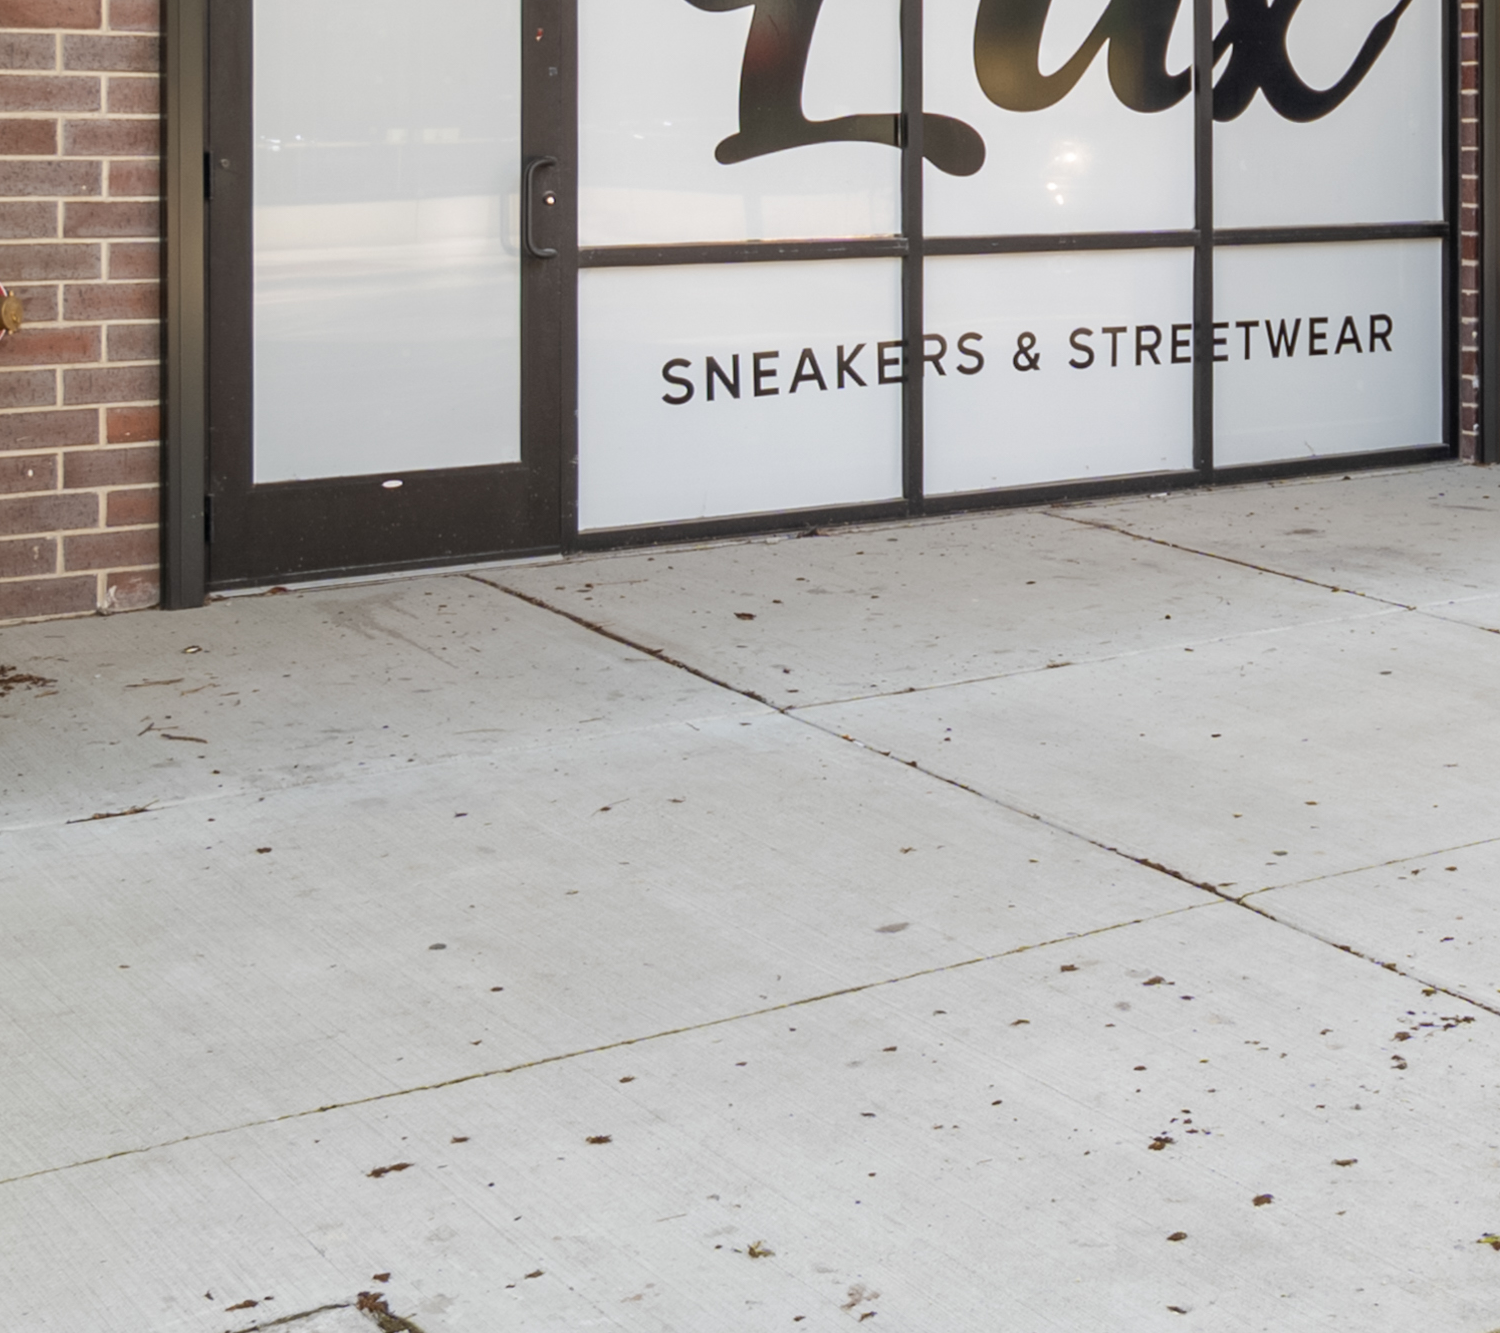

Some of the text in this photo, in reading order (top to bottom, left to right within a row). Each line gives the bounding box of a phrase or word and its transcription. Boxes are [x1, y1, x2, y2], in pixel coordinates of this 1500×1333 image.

[661, 312, 1395, 406] SNEAKERS & STREETWEAR
